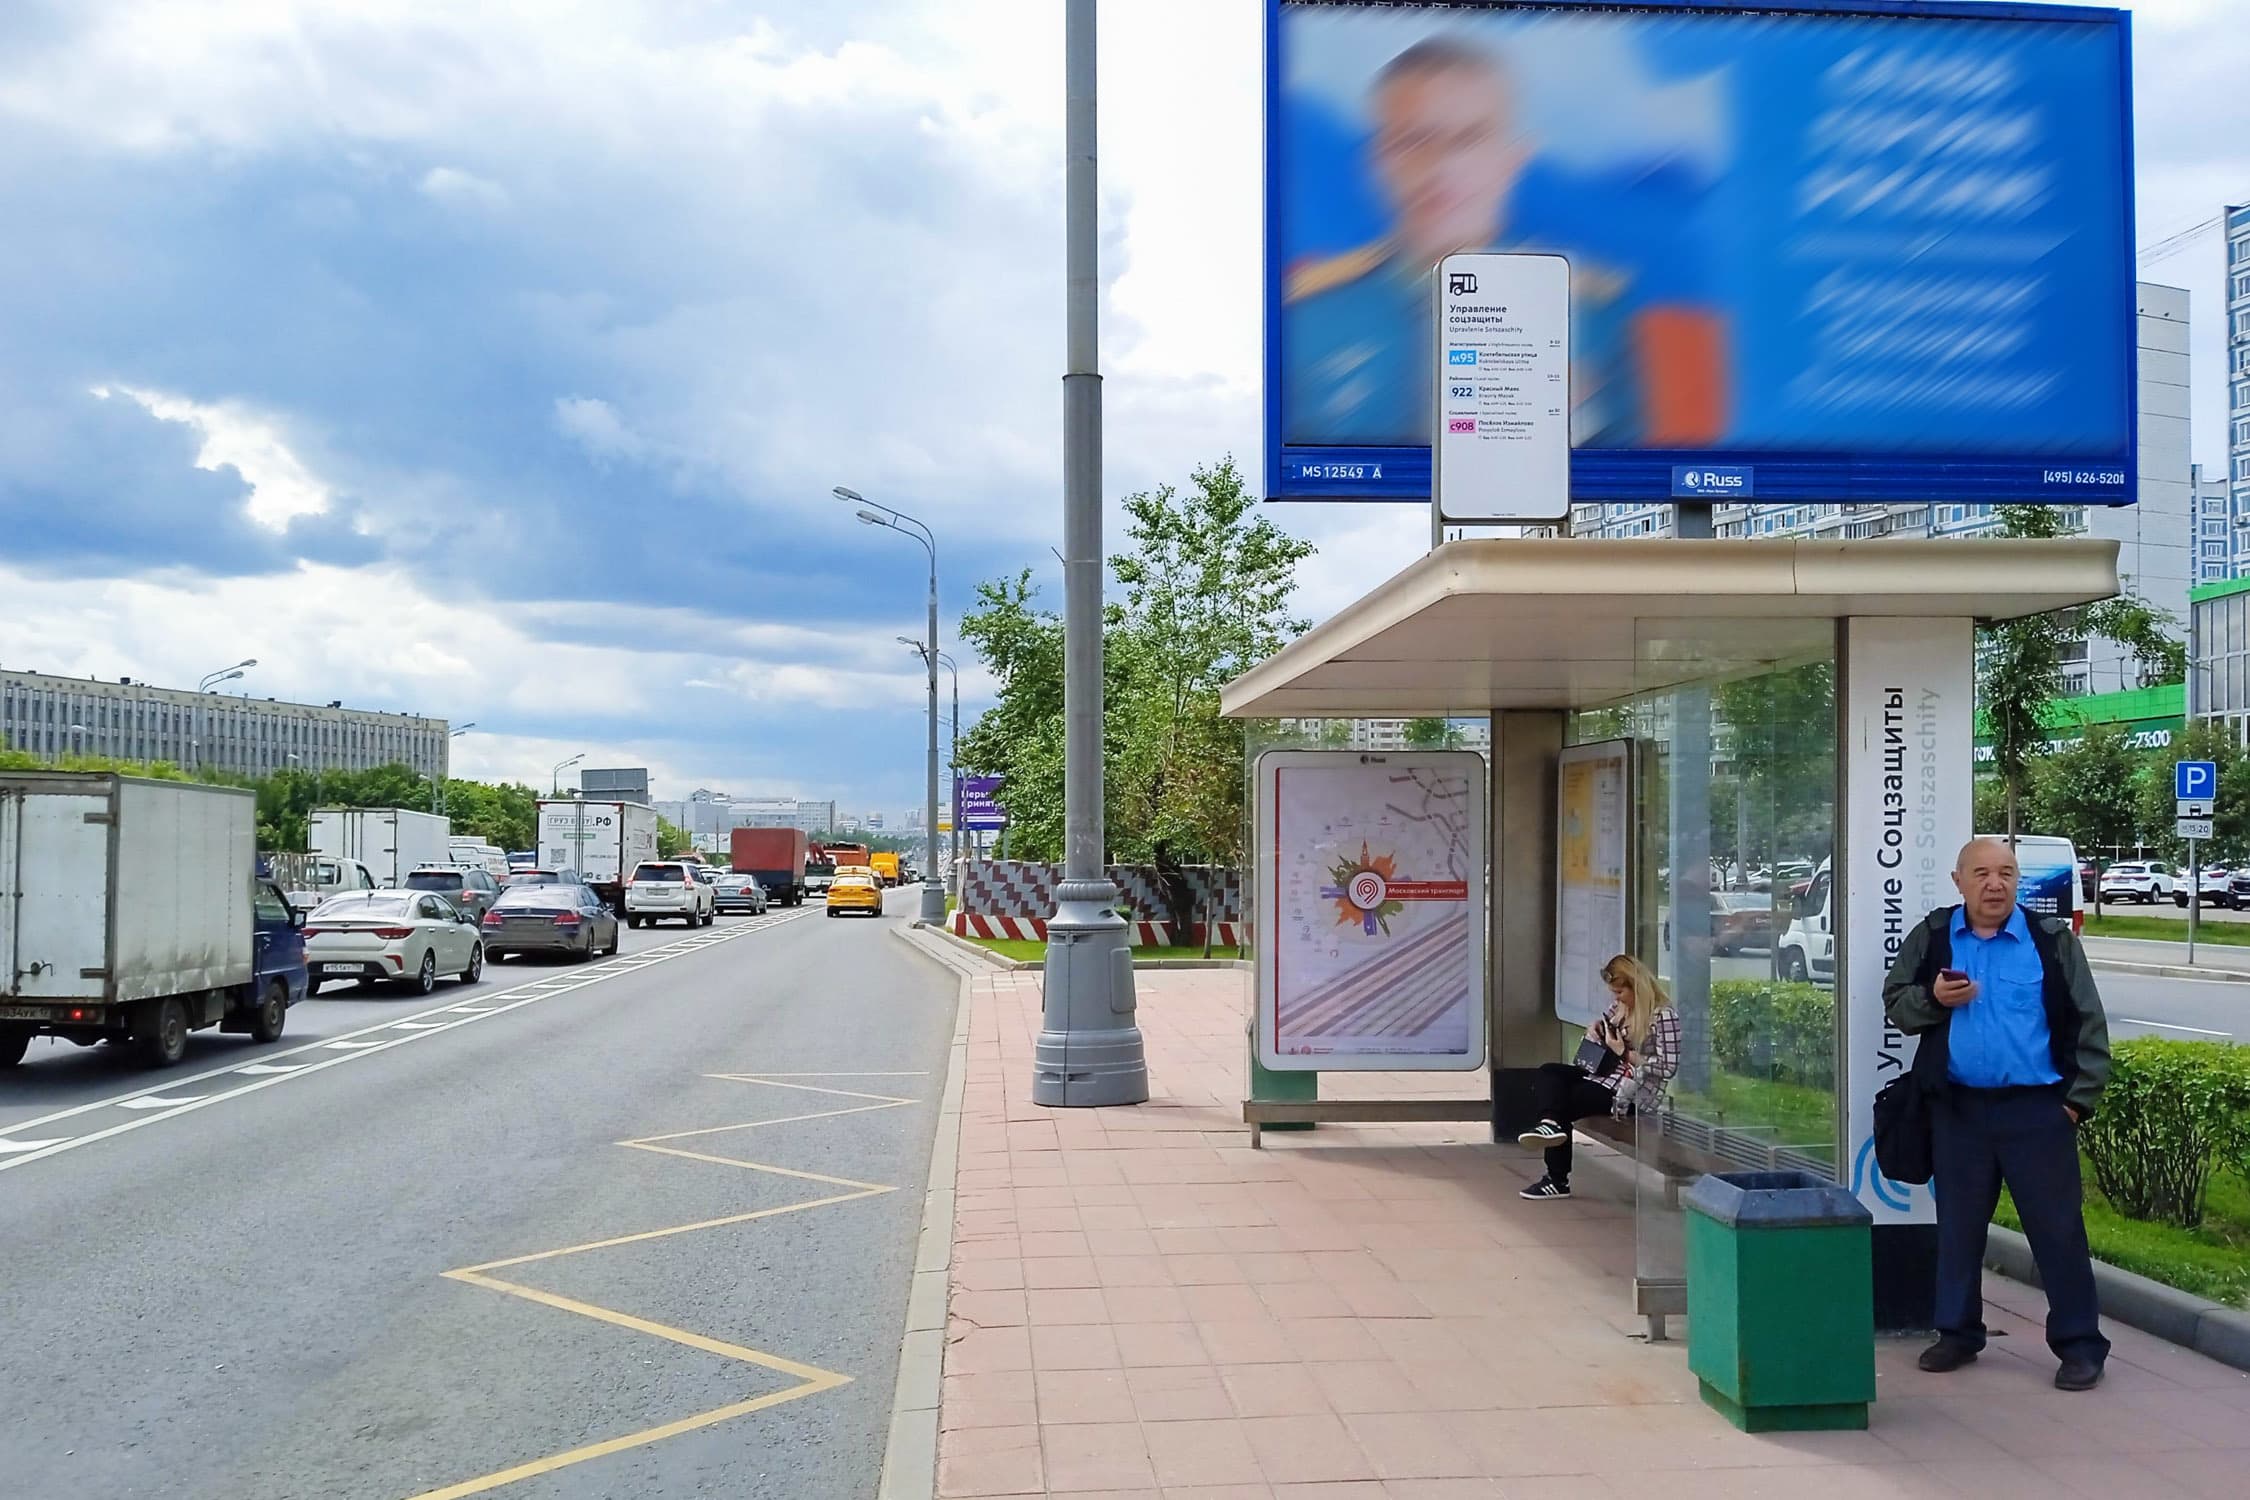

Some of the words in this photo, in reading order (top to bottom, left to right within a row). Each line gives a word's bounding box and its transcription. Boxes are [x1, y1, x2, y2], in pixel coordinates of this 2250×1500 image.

[1450, 304, 1507, 314] Управление
[1449, 316, 1503, 324] соцзащиты
[1449, 326, 1483, 334] Upravlenie
[1452, 387, 1473, 397] 922
[1450, 423, 1474, 431] с908
[1372, 467, 1382, 479] A
[1704, 472, 1743, 487] Russ
[1915, 687, 1941, 849] Sotszaschity
[1877, 688, 1907, 869] Соцзащиты
[2187, 767, 2207, 794] P
[549, 817, 569, 825] ГРУЗ
[571, 817, 591, 825] ВУ
[1877, 878, 1904, 1071] Упение
